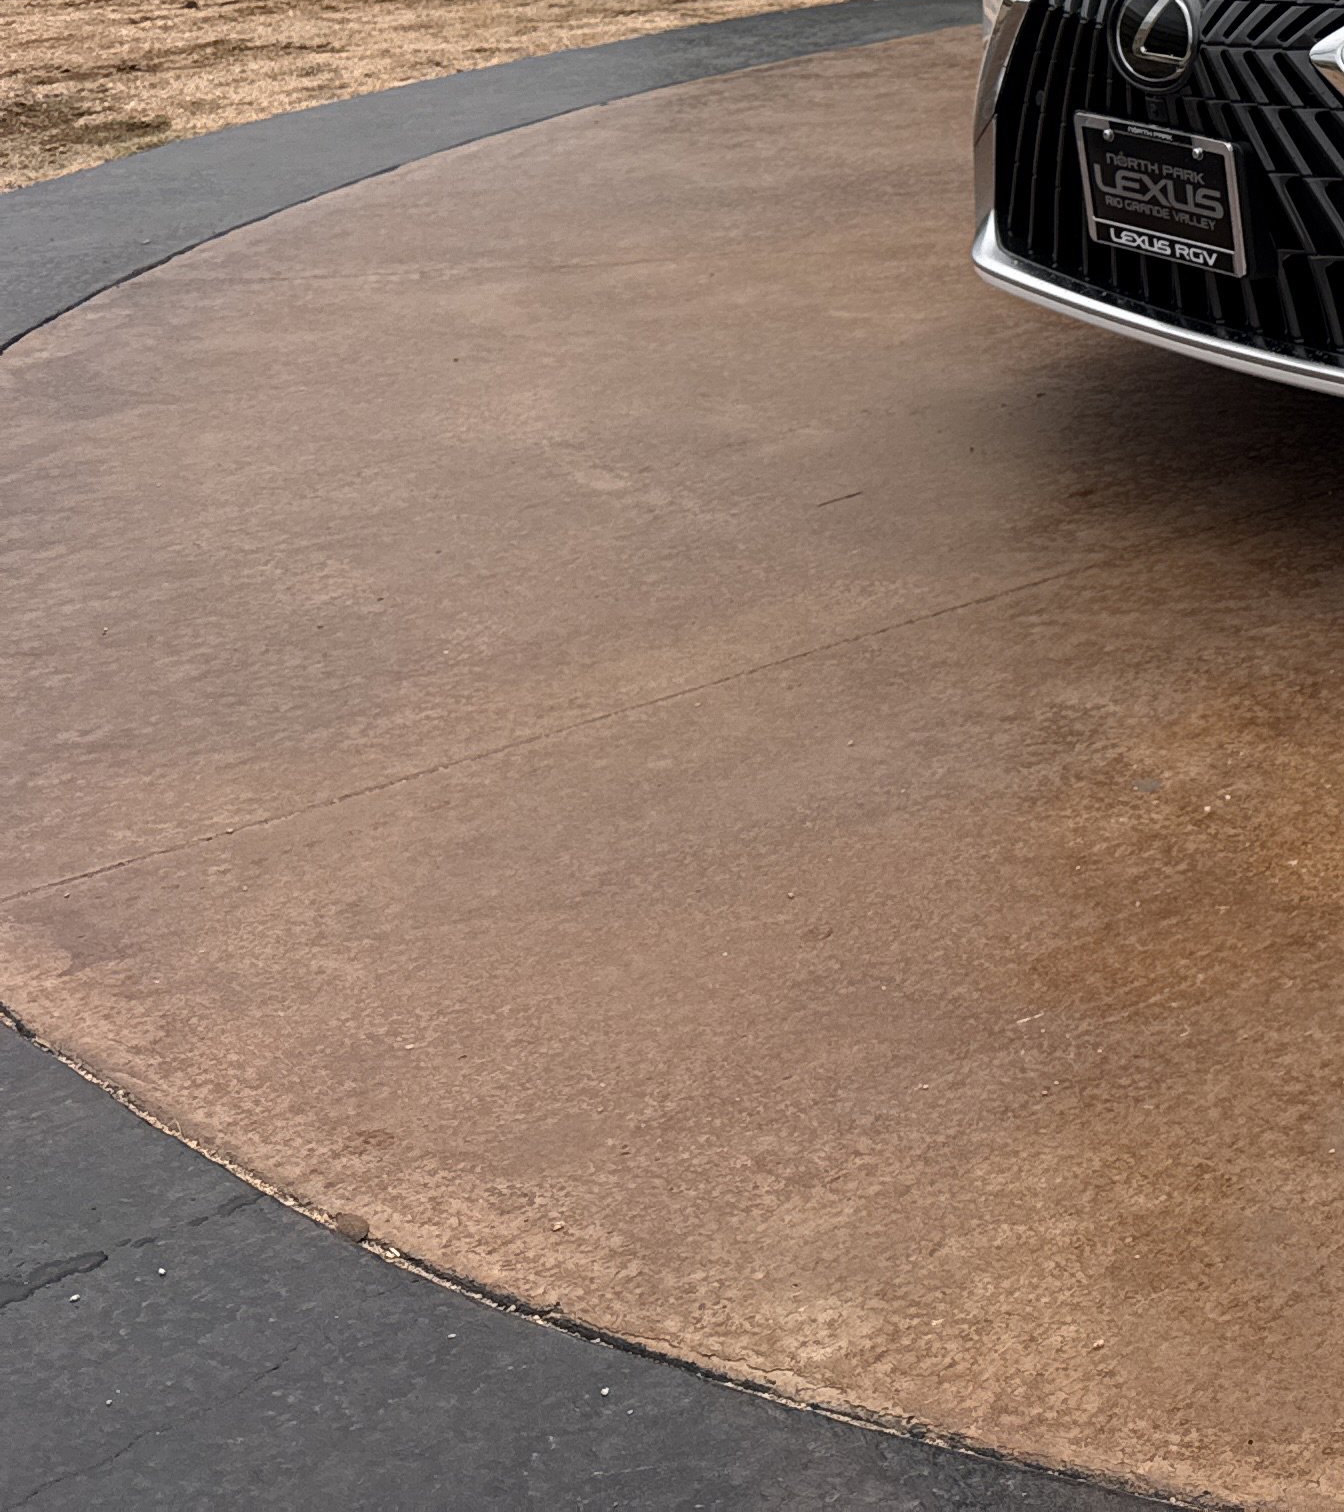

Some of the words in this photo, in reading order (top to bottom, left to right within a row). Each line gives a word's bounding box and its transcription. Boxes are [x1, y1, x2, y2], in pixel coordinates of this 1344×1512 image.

[1094, 163, 1224, 220] LEXUS
[1162, 165, 1205, 185] PARK
[1105, 195, 1123, 209] RIO
[1124, 197, 1170, 219] GRANDE
[1171, 209, 1217, 231] VALLEY
[1109, 228, 1171, 255] LEXUS
[1175, 244, 1217, 266] RGV
